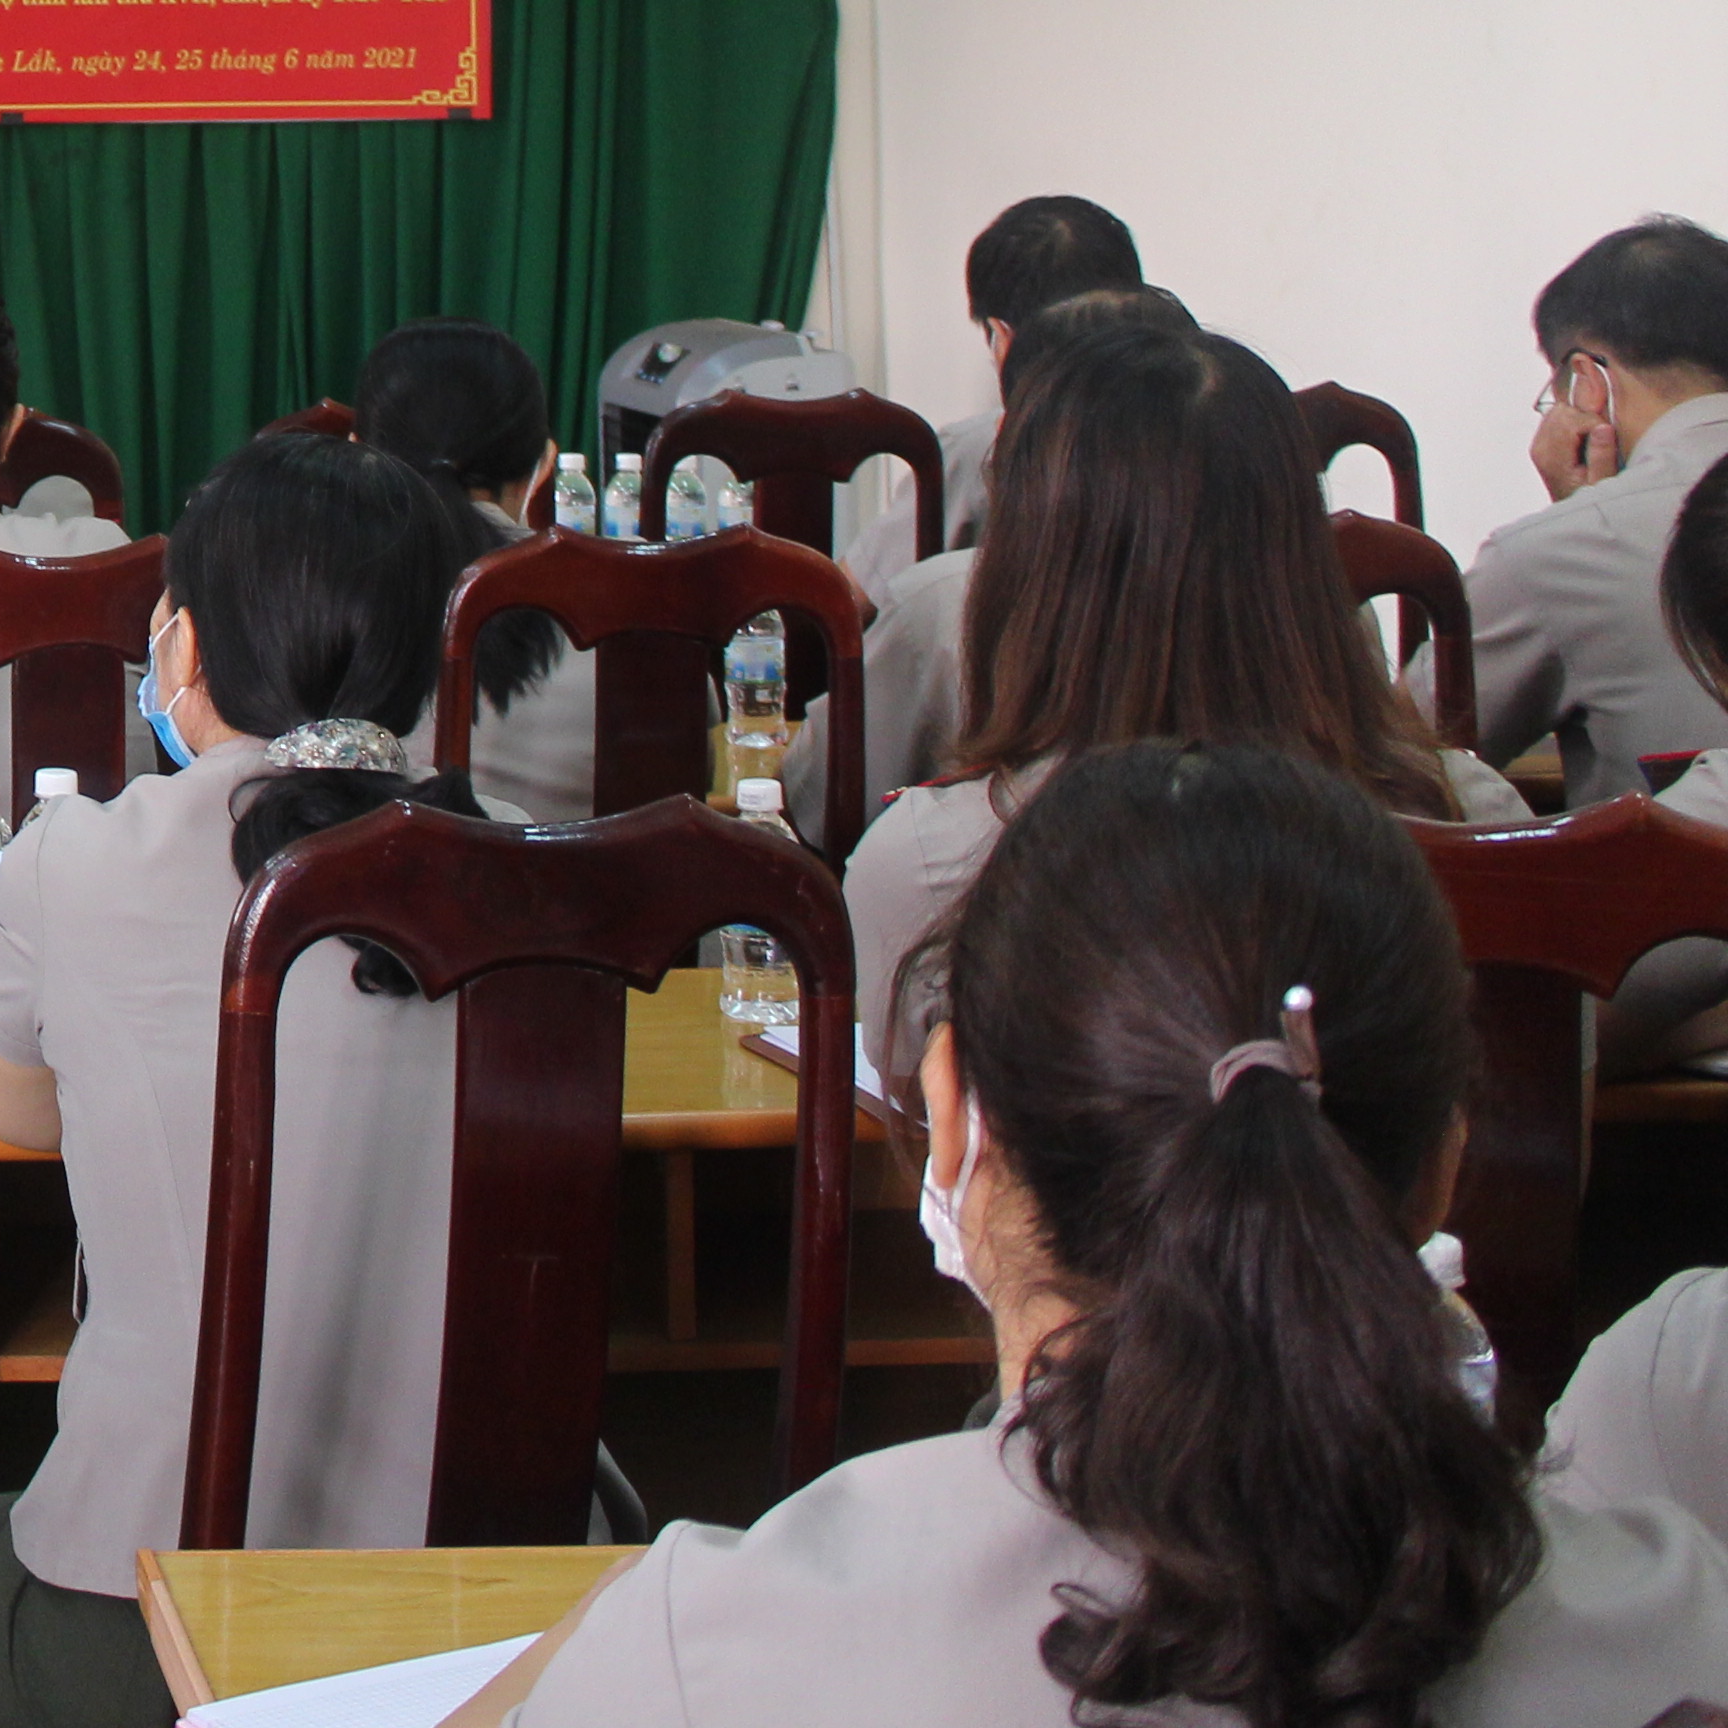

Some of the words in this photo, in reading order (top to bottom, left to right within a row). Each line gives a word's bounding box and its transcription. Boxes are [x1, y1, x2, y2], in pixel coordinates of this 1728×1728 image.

[72, 52, 127, 78] ngày
[133, 50, 168, 73] 24,
[175, 49, 204, 72] 25
[211, 48, 278, 76] tháng
[284, 48, 301, 70] 6
[306, 51, 356, 70] năm
[363, 47, 418, 70] 2021
